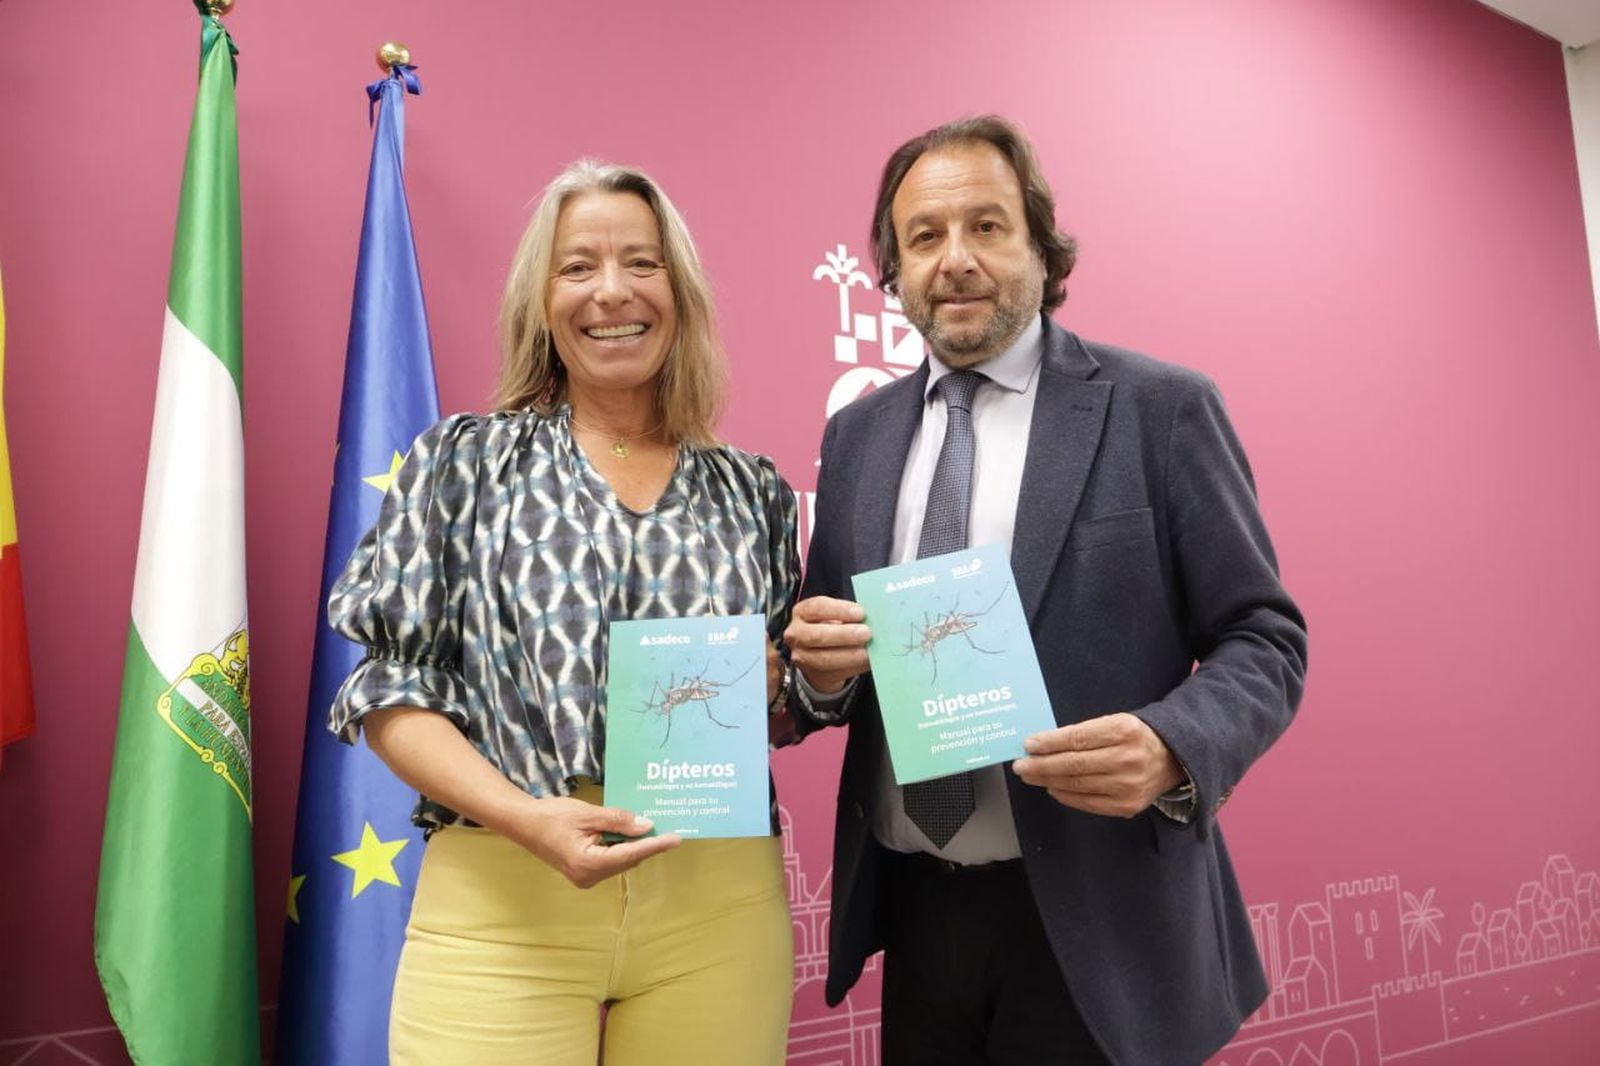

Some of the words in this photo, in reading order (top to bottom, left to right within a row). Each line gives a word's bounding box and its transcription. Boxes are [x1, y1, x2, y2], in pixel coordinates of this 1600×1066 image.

[923, 686, 1012, 717] Dípteros
[200, 699, 231, 736] PARA
[930, 737, 979, 755] prevención
[984, 725, 1017, 742] control
[939, 727, 971, 741] Manual
[970, 723, 991, 737] para
[647, 759, 735, 783] Dípteros
[643, 805, 691, 818] prevención
[699, 804, 731, 816] control
[655, 797, 687, 806] Manual
[687, 797, 707, 807] para
